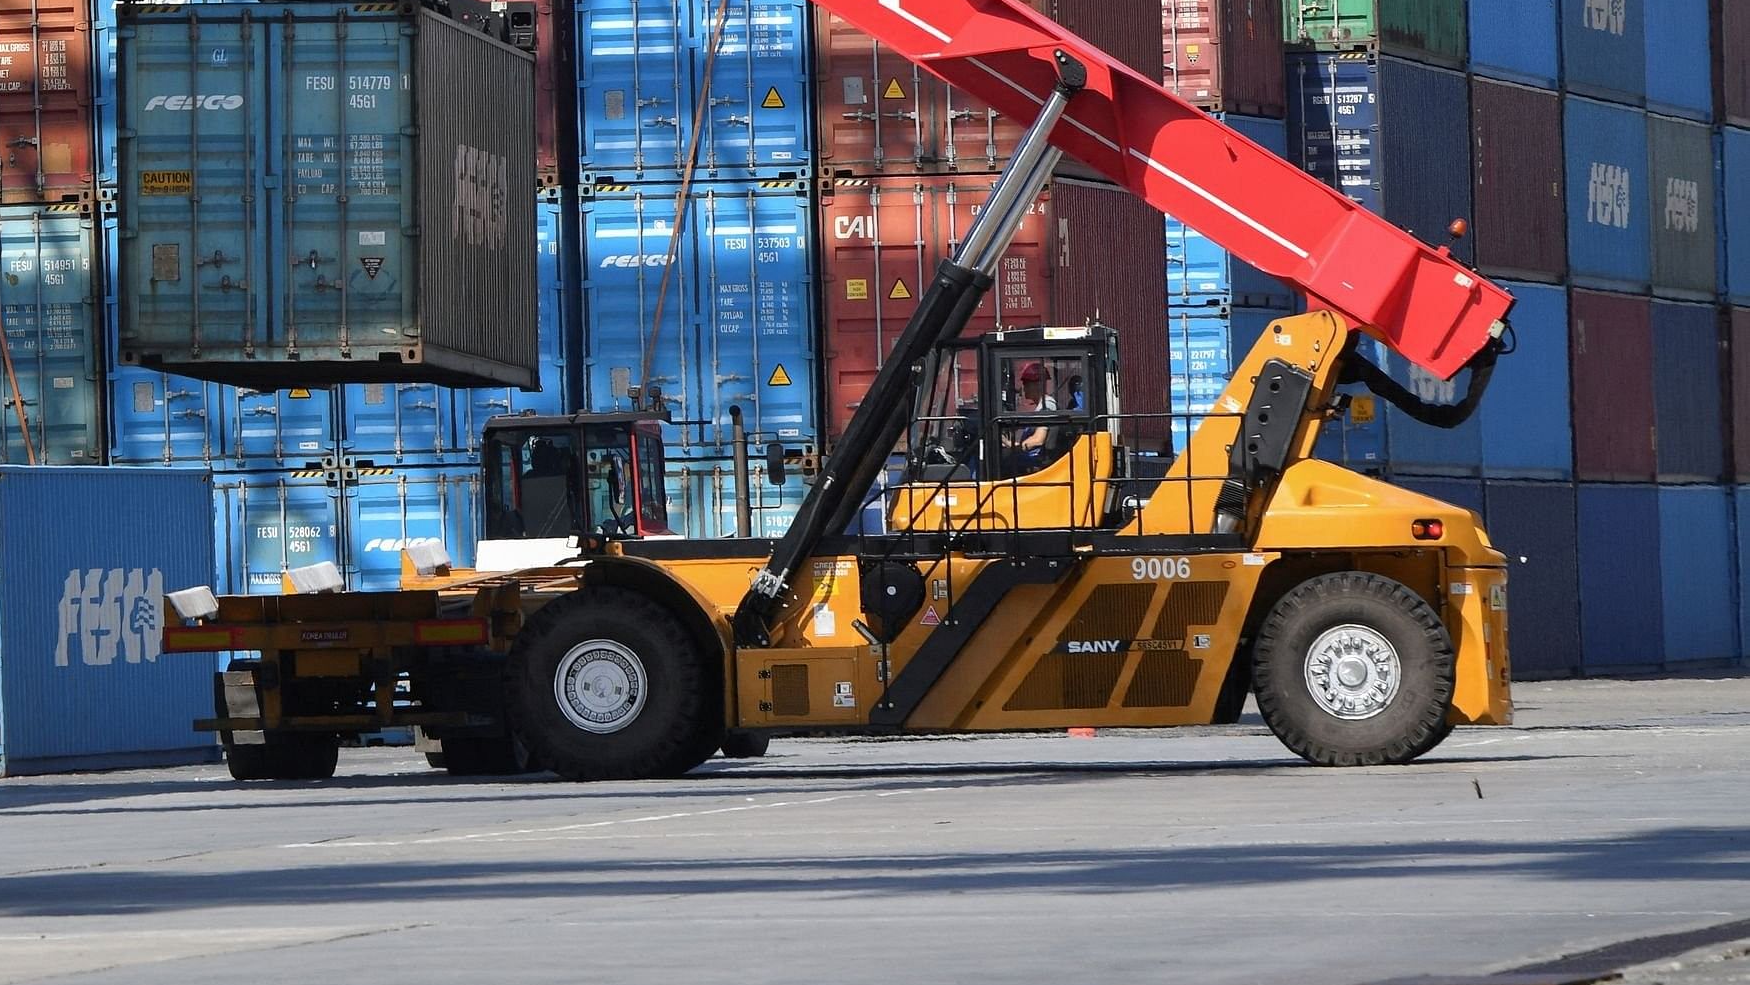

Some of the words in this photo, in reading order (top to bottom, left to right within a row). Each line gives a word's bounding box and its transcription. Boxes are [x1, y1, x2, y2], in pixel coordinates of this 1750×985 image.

[213, 49, 227, 62] GL
[306, 76, 334, 90] FESU
[349, 76, 391, 90] 514779
[145, 95, 244, 111] FESCO
[349, 95, 376, 108] 45G1
[1338, 106, 1355, 114] 45G1
[298, 153, 314, 163] TARE
[144, 173, 190, 183] CAUTION
[298, 168, 322, 178] PAYLOAD
[725, 239, 746, 249] FESU
[758, 238, 790, 248] 537503
[758, 252, 779, 263] 45G1
[11, 261, 32, 271] FESU
[45, 260, 75, 270] 514951
[45, 274, 64, 285] 45G1
[258, 527, 277, 538] FESU
[290, 527, 321, 538] 528062
[290, 541, 310, 552] 45G1
[1132, 557, 1190, 580] 9006
[1067, 640, 1120, 653] SANY
